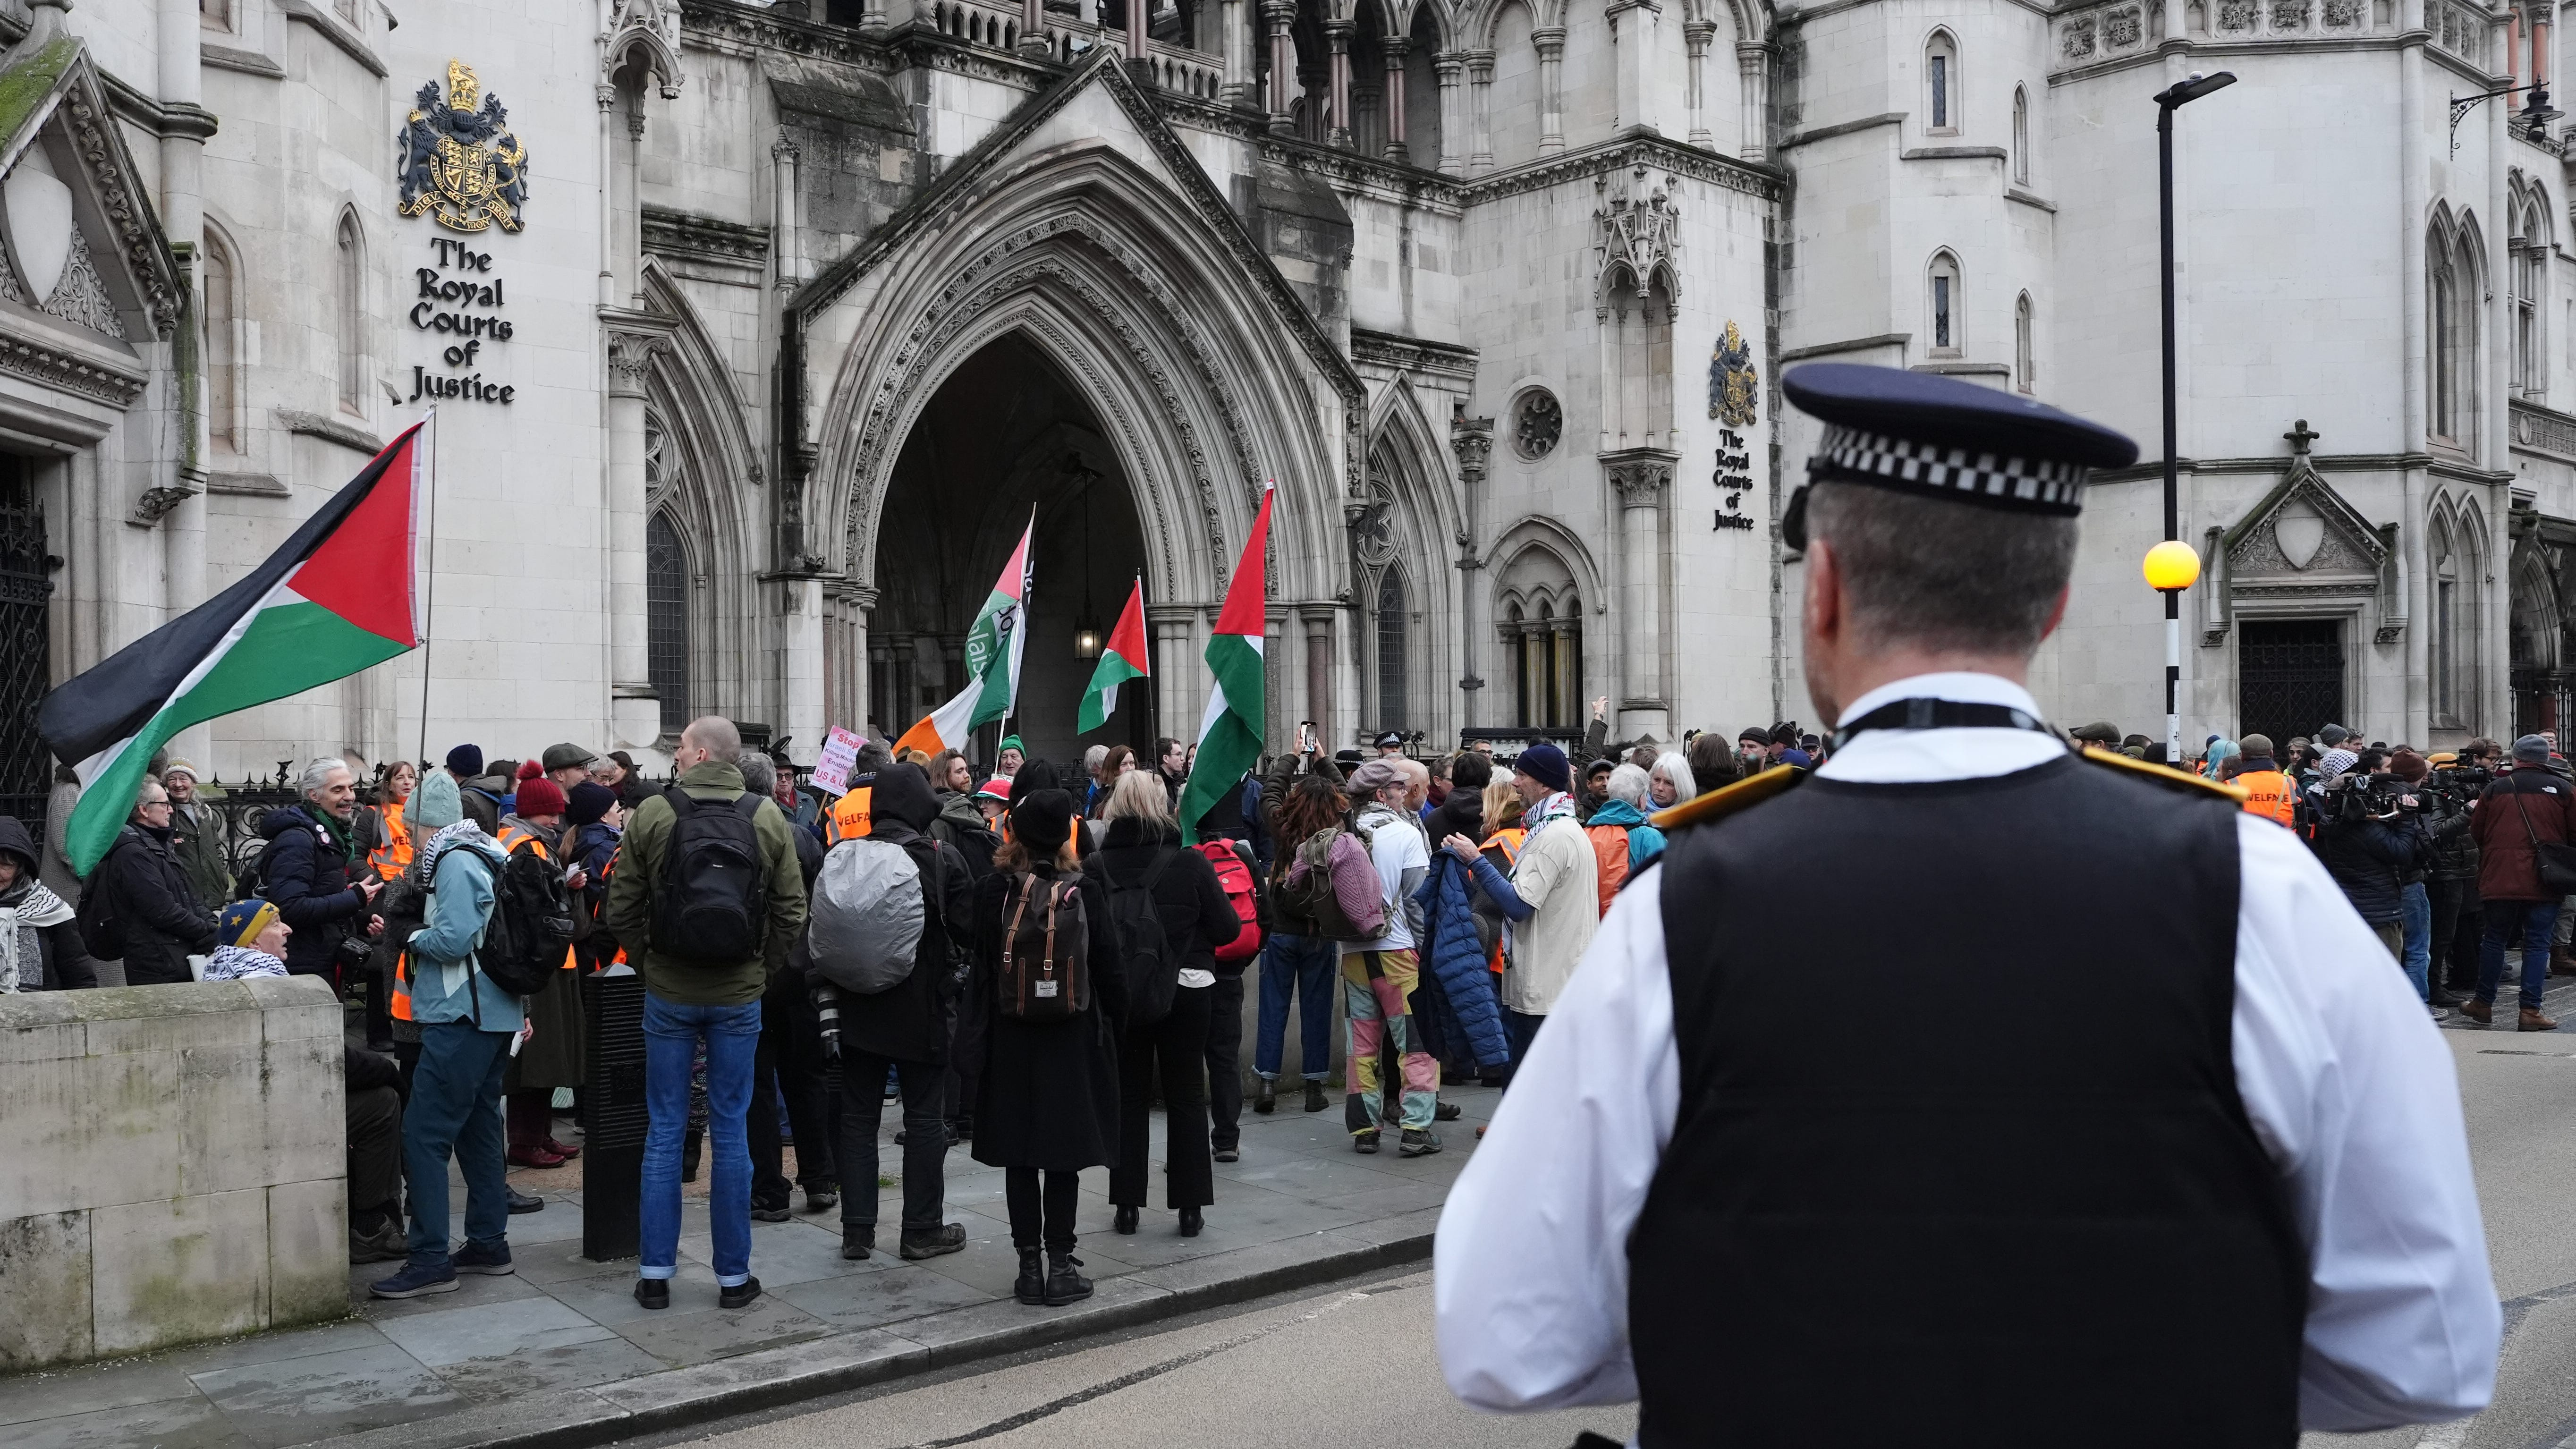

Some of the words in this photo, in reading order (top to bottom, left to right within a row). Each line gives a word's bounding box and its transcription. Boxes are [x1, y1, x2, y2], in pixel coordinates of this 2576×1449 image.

[486, 201, 514, 230] DROIT
[431, 237, 492, 271] The
[416, 268, 505, 308] Royal
[410, 302, 513, 339] Courts
[444, 339, 480, 366] of
[410, 366, 515, 403] Justice
[1720, 429, 1744, 449] The
[1715, 449, 1750, 472] Royal
[1713, 469, 1753, 490] Courts
[1726, 491, 1741, 508] of
[1713, 509, 1754, 531] Justice
[827, 741, 846, 752] Israeli
[847, 748, 857, 757] Sta
[838, 734, 859, 749] Stop
[825, 747, 839, 758] Killing
[816, 769, 829, 780] US
[830, 775, 836, 784] &
[839, 778, 846, 788] U
[2246, 793, 2289, 802] WELFAE
[838, 812, 870, 827] ELFA
